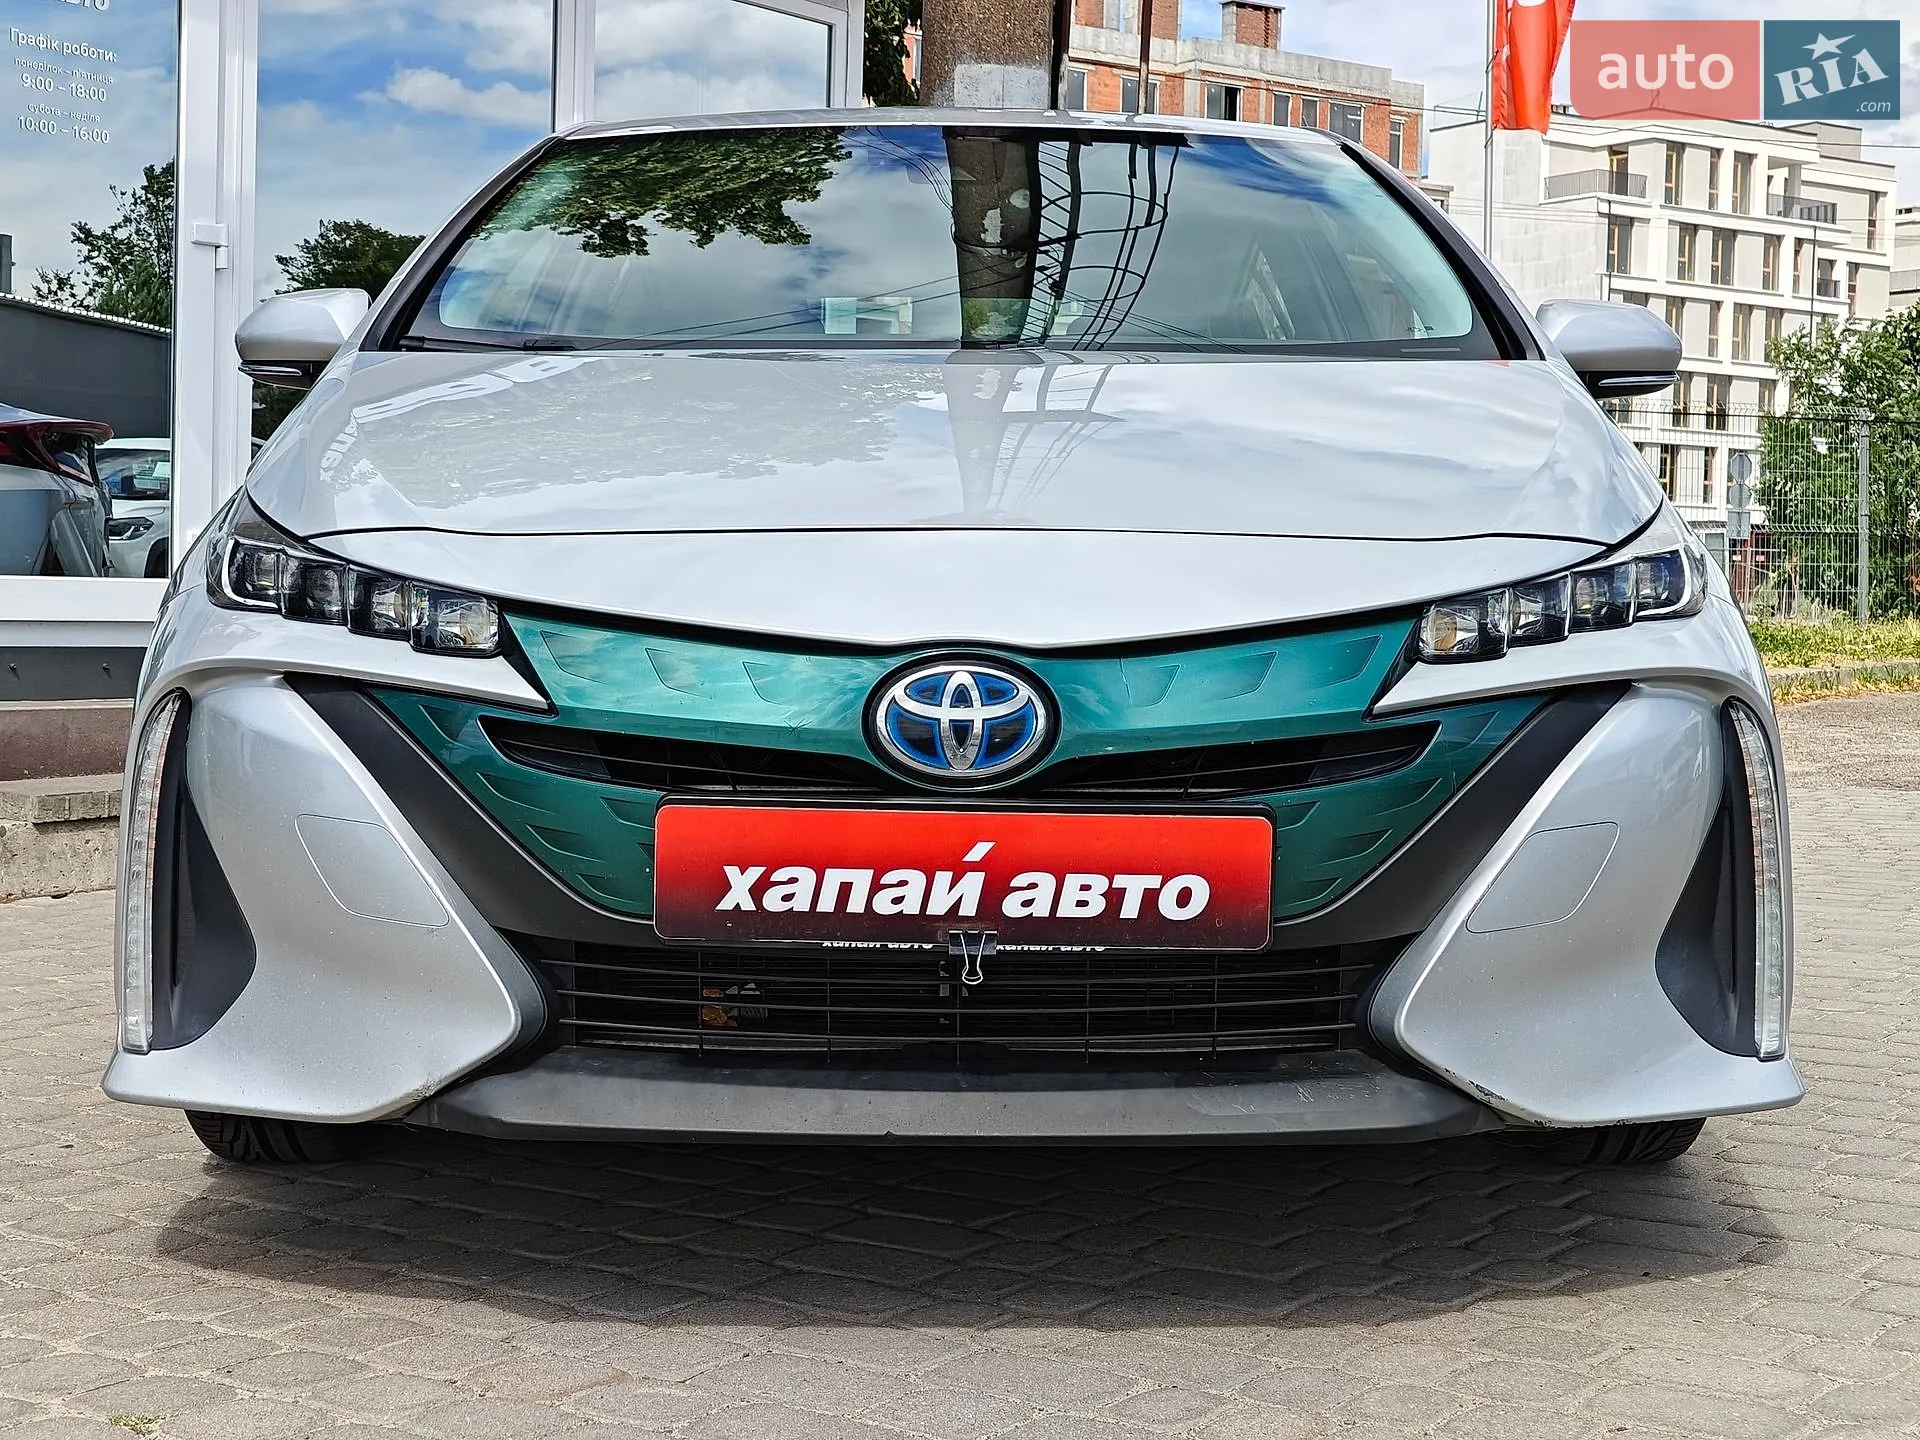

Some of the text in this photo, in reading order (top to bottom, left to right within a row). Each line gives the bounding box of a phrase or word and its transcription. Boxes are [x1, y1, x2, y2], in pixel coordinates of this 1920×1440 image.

[9, 27, 118, 63] Графік роботи:
[13, 58, 62, 74] понеділок
[21, 73, 54, 92] 9:00
[69, 82, 107, 102] 18:00
[27, 103, 60, 117] субота
[69, 111, 101, 123] неділя
[17, 115, 57, 135] 10:00
[71, 125, 110, 144] 16:00
[1001, 870, 1210, 922] авто
